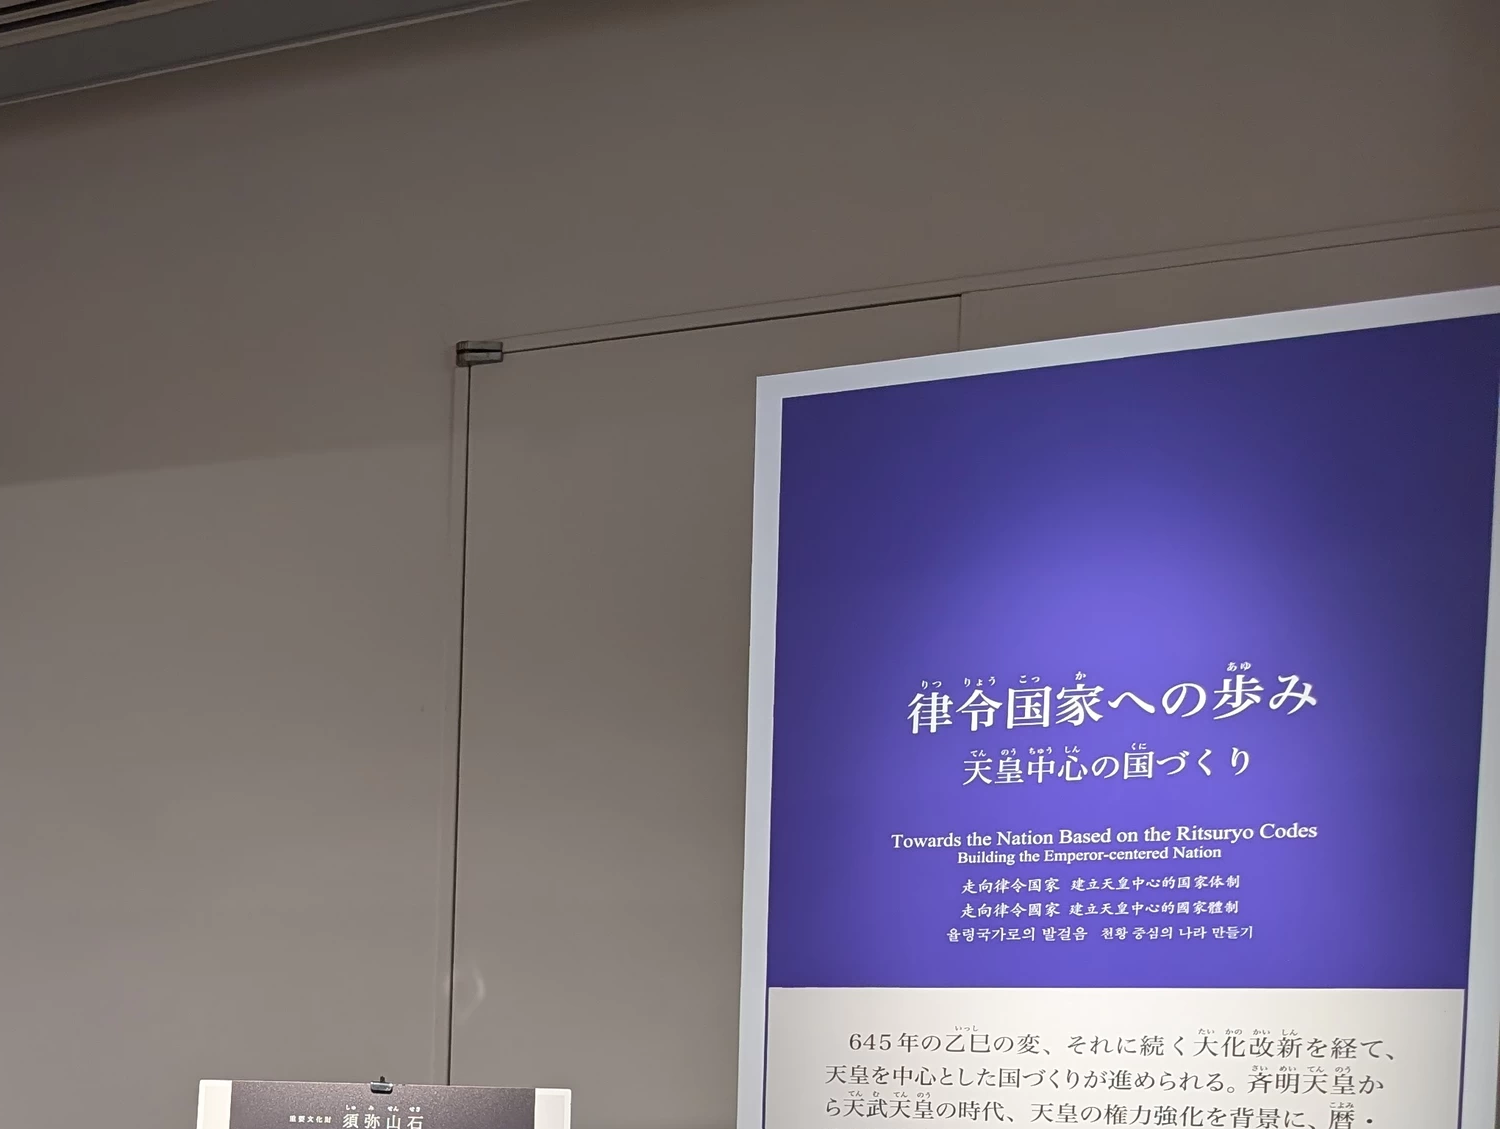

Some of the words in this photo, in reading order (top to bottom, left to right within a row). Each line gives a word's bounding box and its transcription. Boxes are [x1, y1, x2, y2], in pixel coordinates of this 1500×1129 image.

[907, 673, 1317, 734] 律令国家への歩み
[963, 746, 1249, 786] 天皇中心の国づくり
[891, 832, 962, 848] Towards
[967, 831, 992, 847] the
[996, 829, 1054, 846] Nation
[1059, 827, 1111, 844] Based
[1117, 831, 1138, 843] on
[1144, 825, 1171, 842] the
[1176, 825, 1254, 844] Ritsuryo
[1260, 823, 1318, 839] Codes
[958, 850, 1016, 866] Building
[1019, 849, 1040, 862] the
[1044, 846, 1169, 865] Emperor-centered
[1173, 845, 1222, 859] Nation
[961, 876, 1060, 894] 走向律令国家
[1071, 874, 1240, 892] 建立天皇中心的国家体制
[960, 901, 1060, 918] 走向律令國家
[1069, 900, 1239, 916] 建立天皇中心的國家體制
[947, 926, 1035, 942] 율령국가로의
[1042, 926, 1088, 941] 발걸음
[1101, 926, 1128, 940] 천황
[1132, 925, 1173, 940] 중심의
[1179, 925, 1207, 939] 나라
[1212, 925, 1253, 939] 만들기
